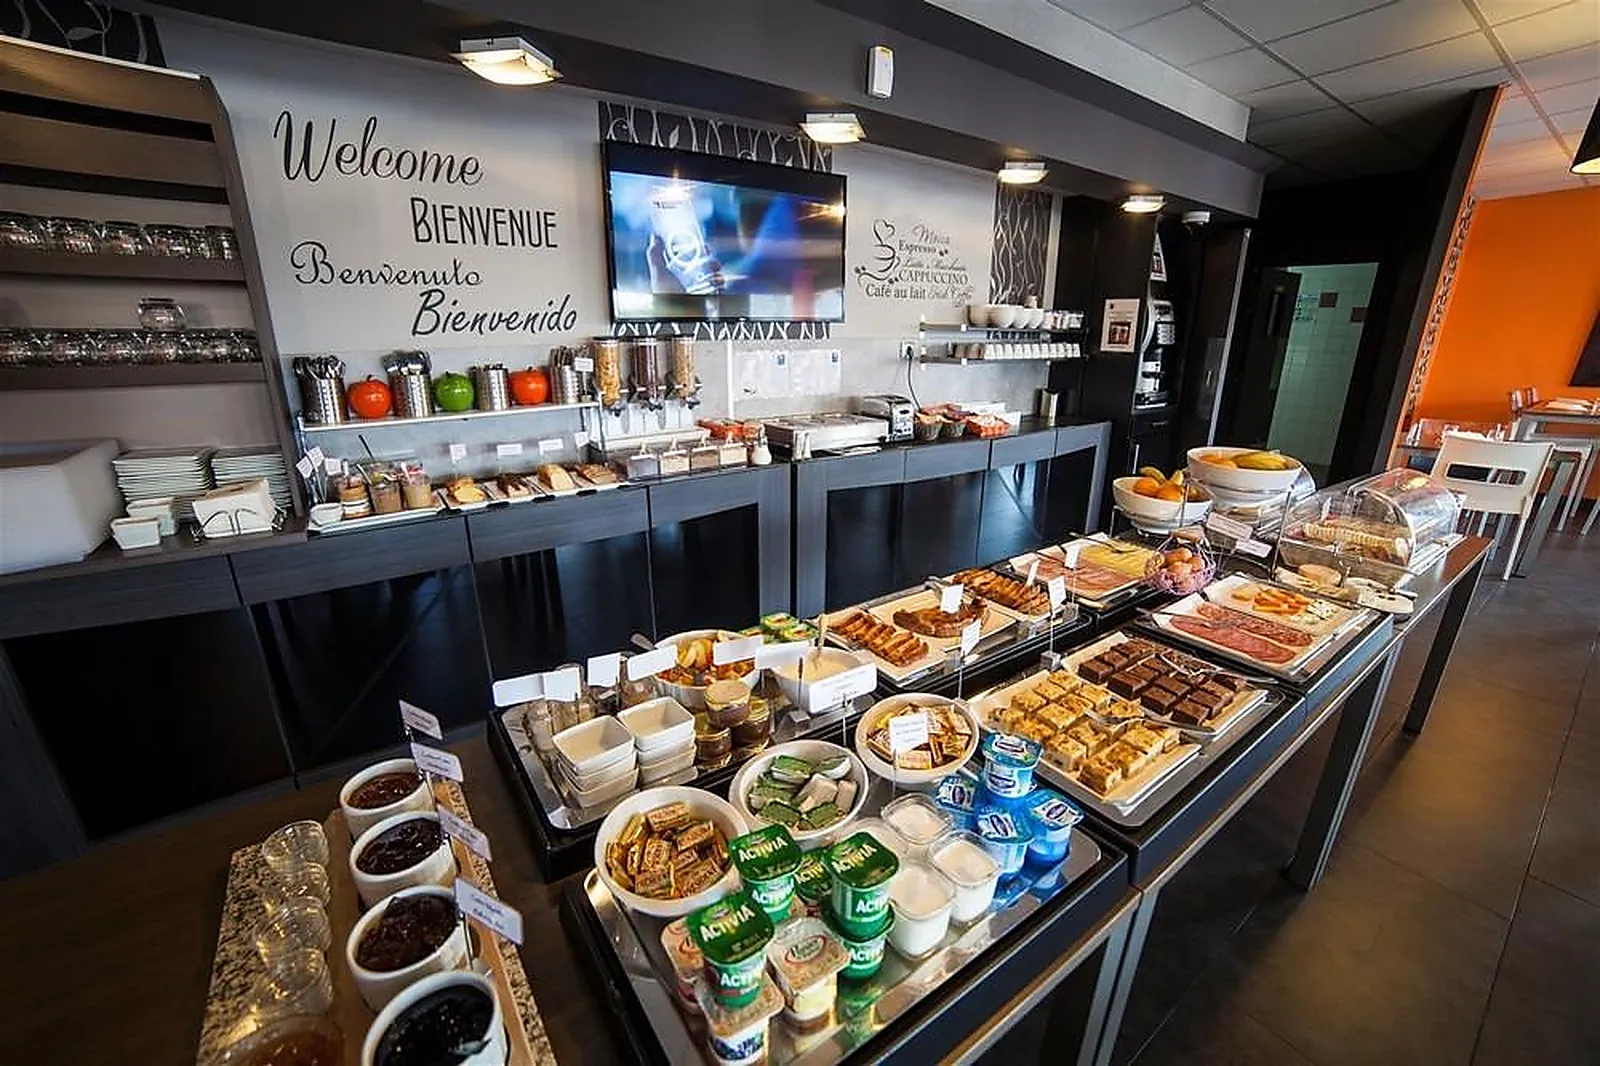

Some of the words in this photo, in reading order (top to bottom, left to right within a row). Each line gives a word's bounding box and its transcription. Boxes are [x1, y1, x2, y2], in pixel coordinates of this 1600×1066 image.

[273, 110, 484, 186] Welcome
[410, 197, 558, 249] BIENVENUE
[290, 240, 483, 286] Benvenuto
[899, 269, 968, 285] CAPPUCCINO
[411, 288, 578, 336] Bienvenido
[865, 283, 891, 298] Café
[894, 288, 907, 299] au
[910, 286, 925, 300] lait
[794, 863, 825, 885] ACTIV
